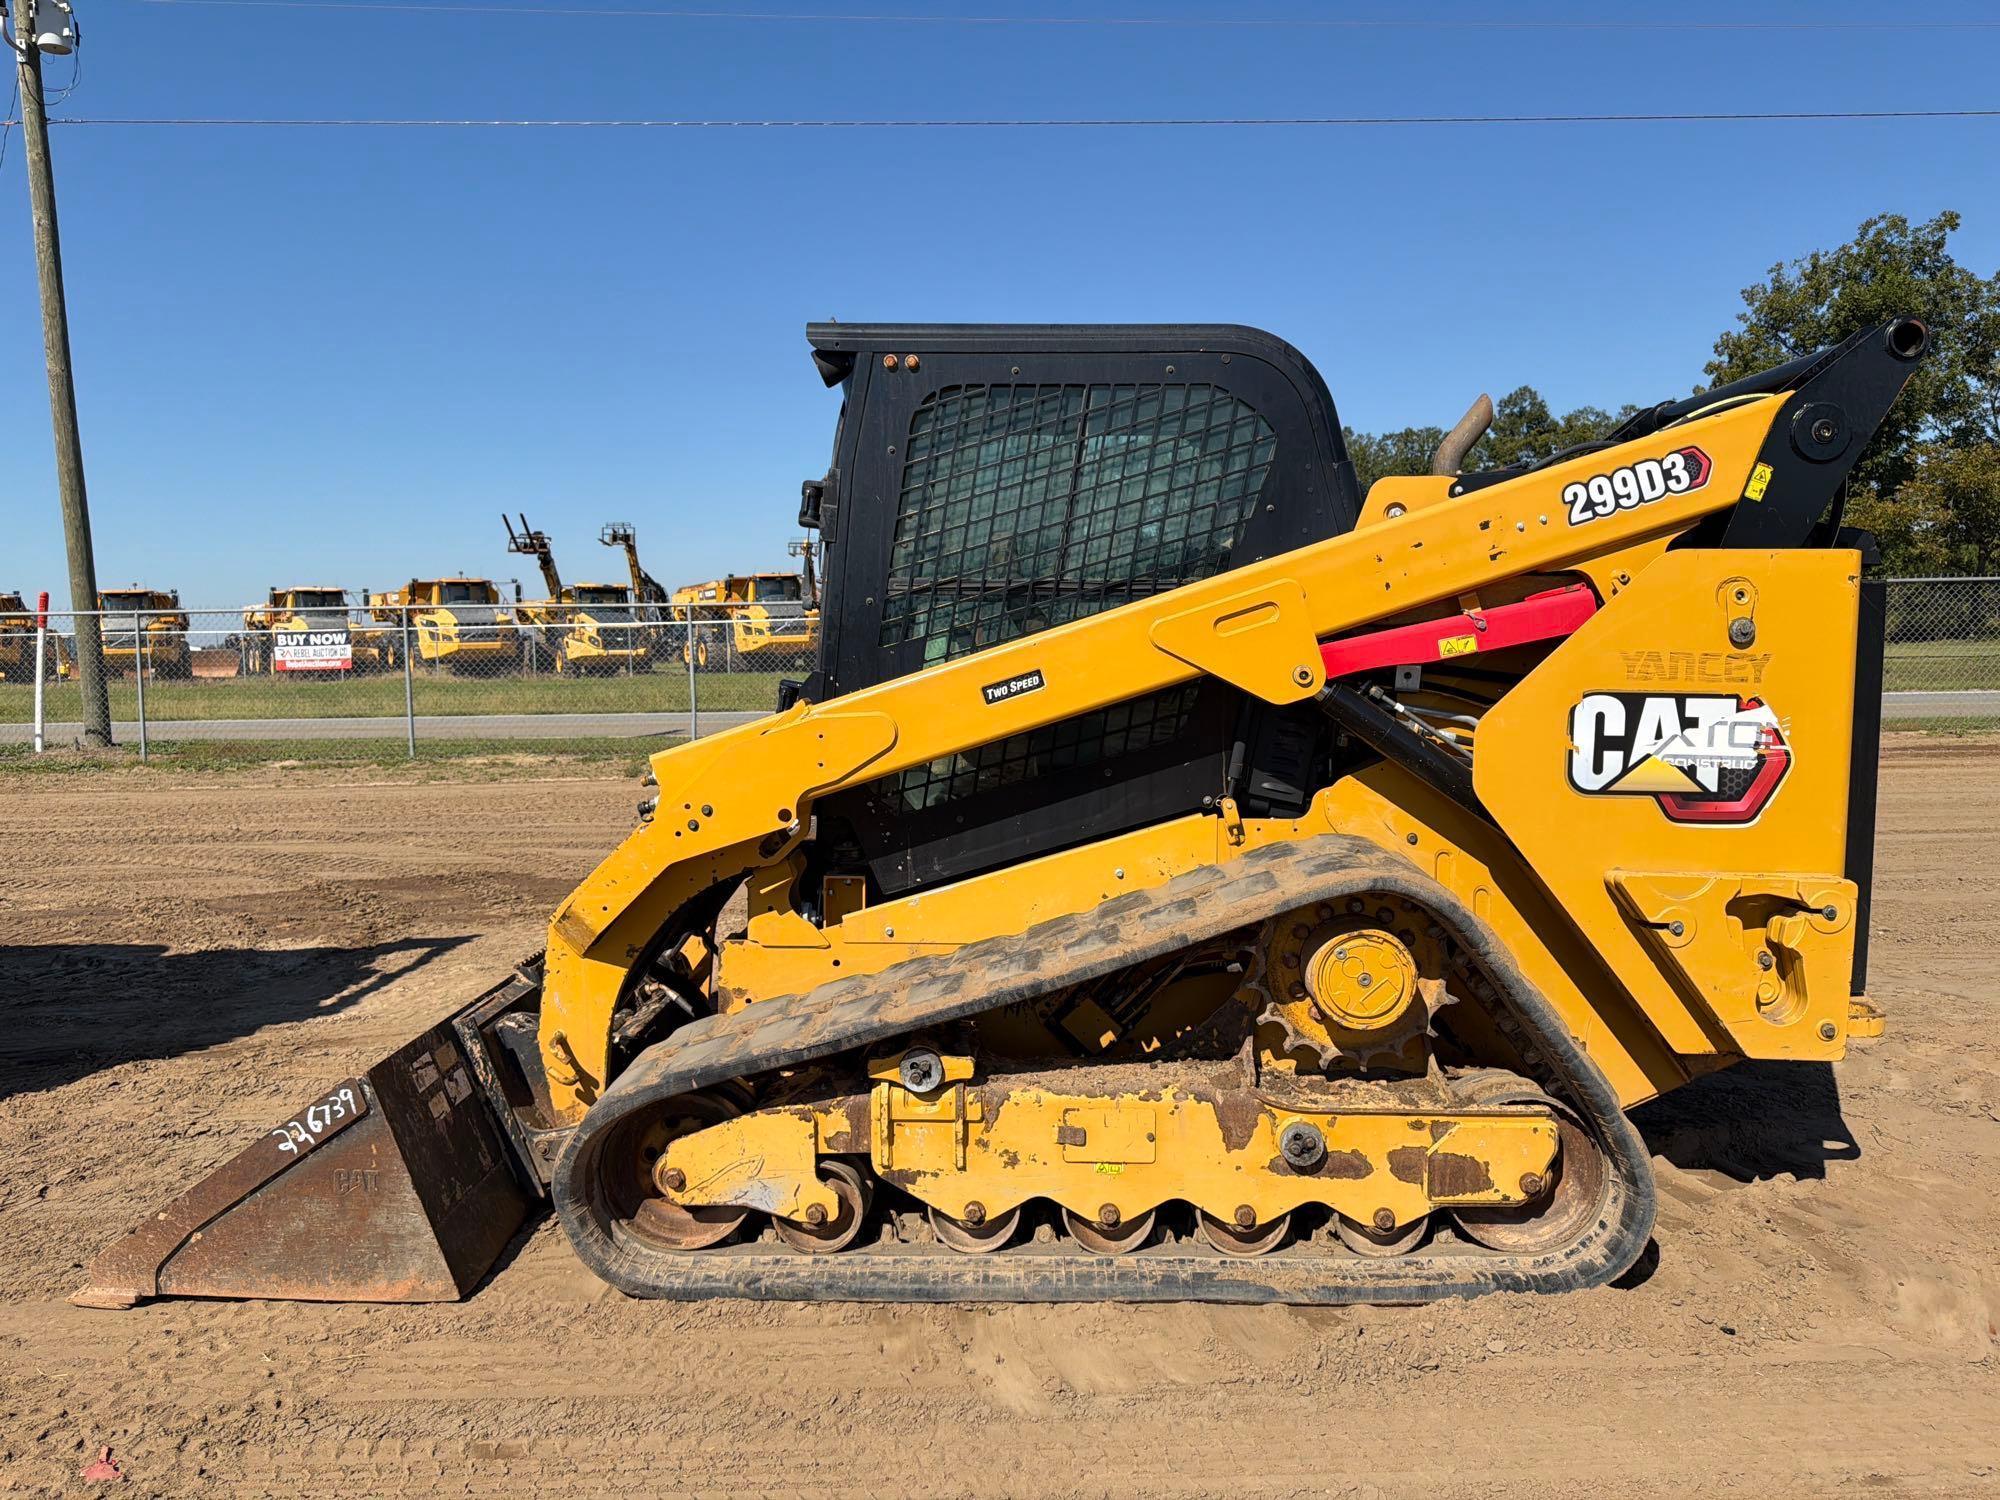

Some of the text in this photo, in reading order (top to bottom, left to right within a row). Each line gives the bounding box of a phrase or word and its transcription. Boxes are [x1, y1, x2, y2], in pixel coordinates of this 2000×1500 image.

[1563, 452, 1691, 525] 299D3
[277, 633, 347, 646] BUY NOW
[293, 648, 311, 658] REBEL
[312, 647, 338, 658] AUCTION
[986, 675, 1040, 700] TWO SPEED
[1571, 694, 1738, 793] CAT
[272, 1088, 357, 1155] 226739
[333, 1168, 380, 1196] CAT
